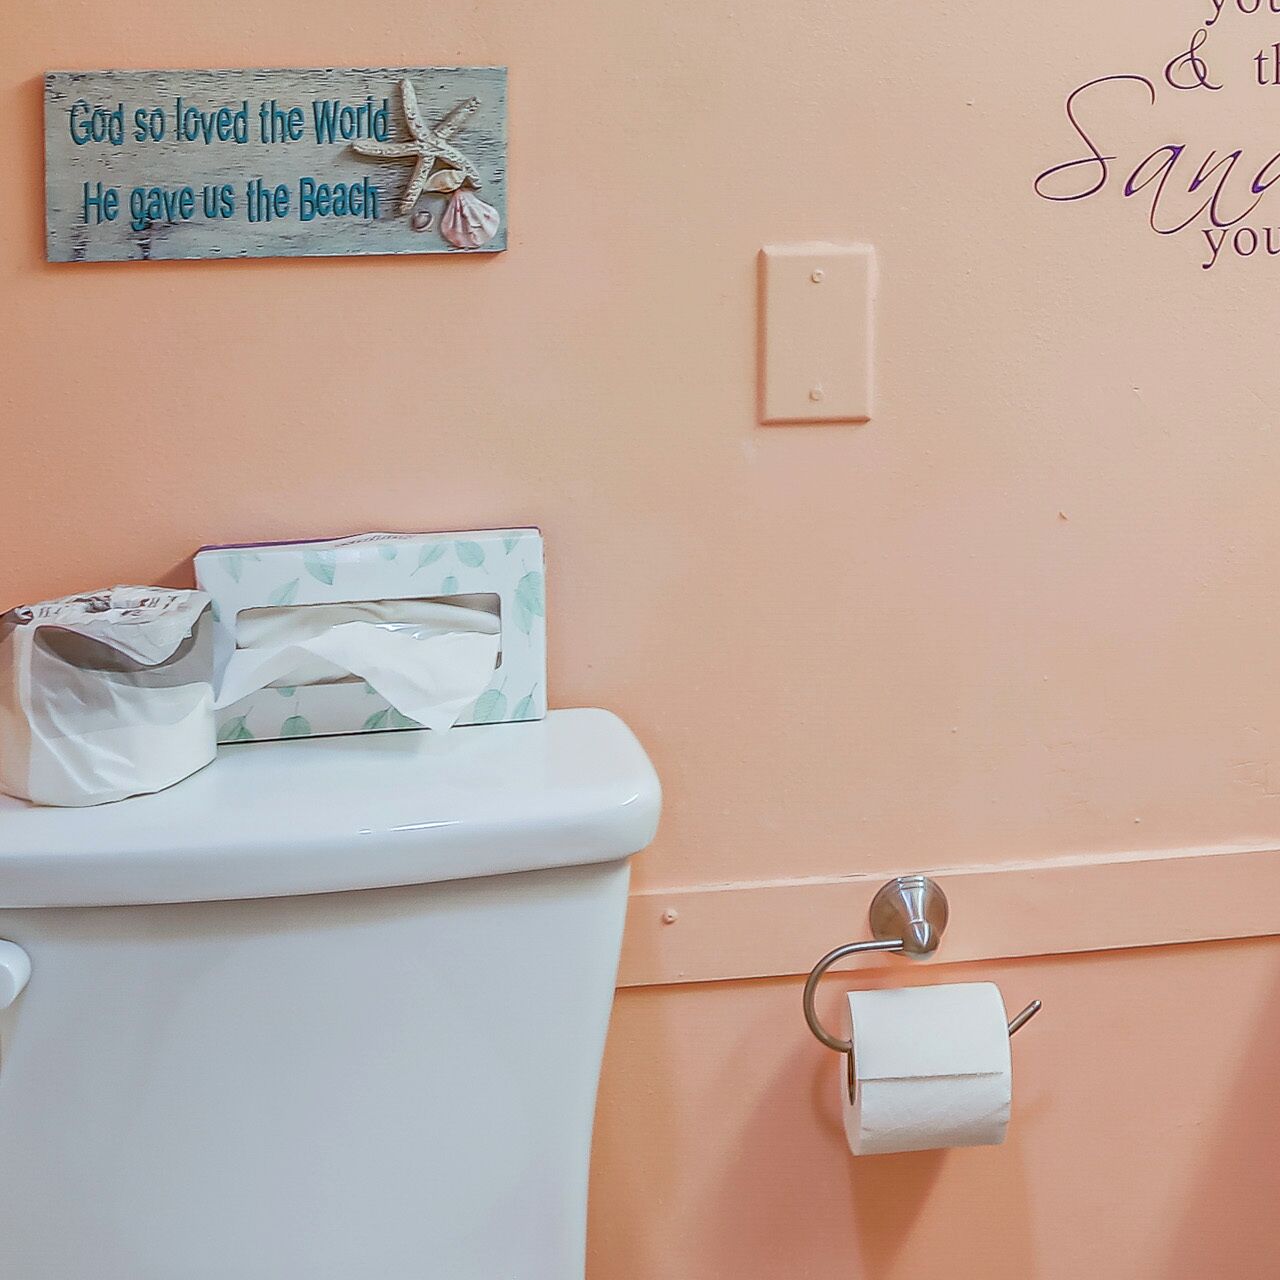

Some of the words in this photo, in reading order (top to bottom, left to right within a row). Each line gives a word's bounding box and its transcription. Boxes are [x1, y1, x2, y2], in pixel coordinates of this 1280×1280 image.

[1164, 28, 1224, 91] &
[69, 98, 125, 146] God
[134, 106, 166, 144] so
[176, 96, 249, 146] loved
[259, 99, 304, 145] the
[312, 95, 391, 145] World
[83, 181, 119, 225] He
[130, 185, 196, 232] gave
[203, 182, 235, 219] us
[247, 178, 290, 224] the
[299, 176, 379, 222] Beach
